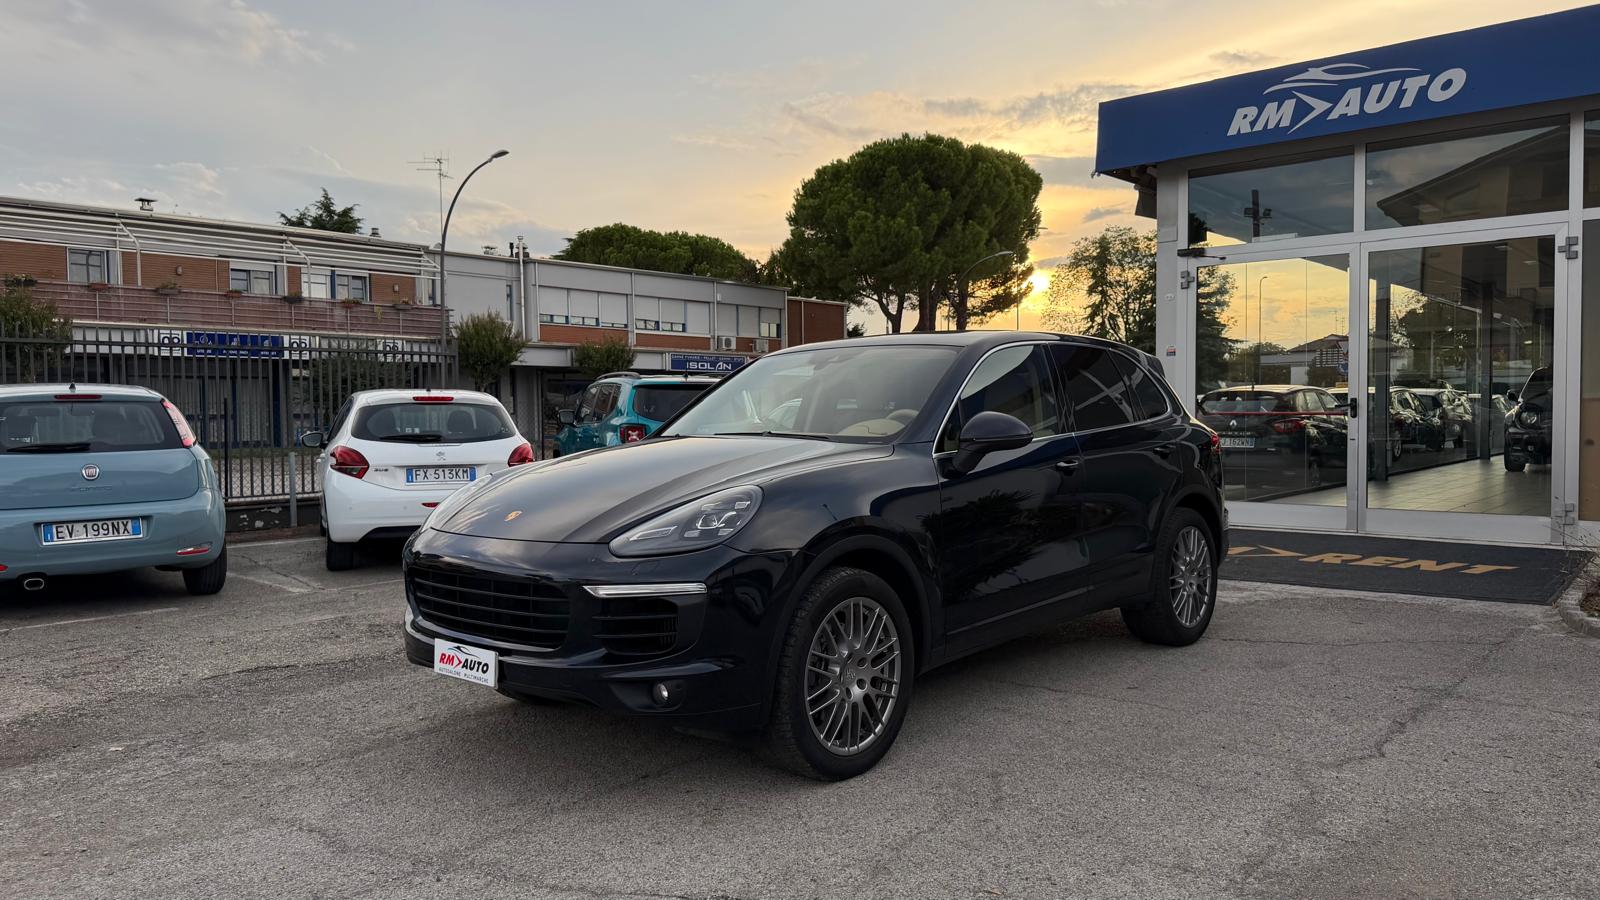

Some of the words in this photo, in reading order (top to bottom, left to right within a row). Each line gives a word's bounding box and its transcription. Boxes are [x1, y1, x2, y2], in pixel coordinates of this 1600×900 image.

[1226, 99, 1296, 136] RM
[1326, 67, 1467, 120] AUTO
[686, 361, 732, 371] ISOLAN
[414, 469, 429, 480] FX
[434, 468, 469, 479] 513KM
[55, 525, 75, 539] EV
[83, 521, 130, 537] 199NX
[1300, 552, 1520, 574] RENT
[439, 652, 455, 666] RM
[462, 658, 489, 674] AUTO
